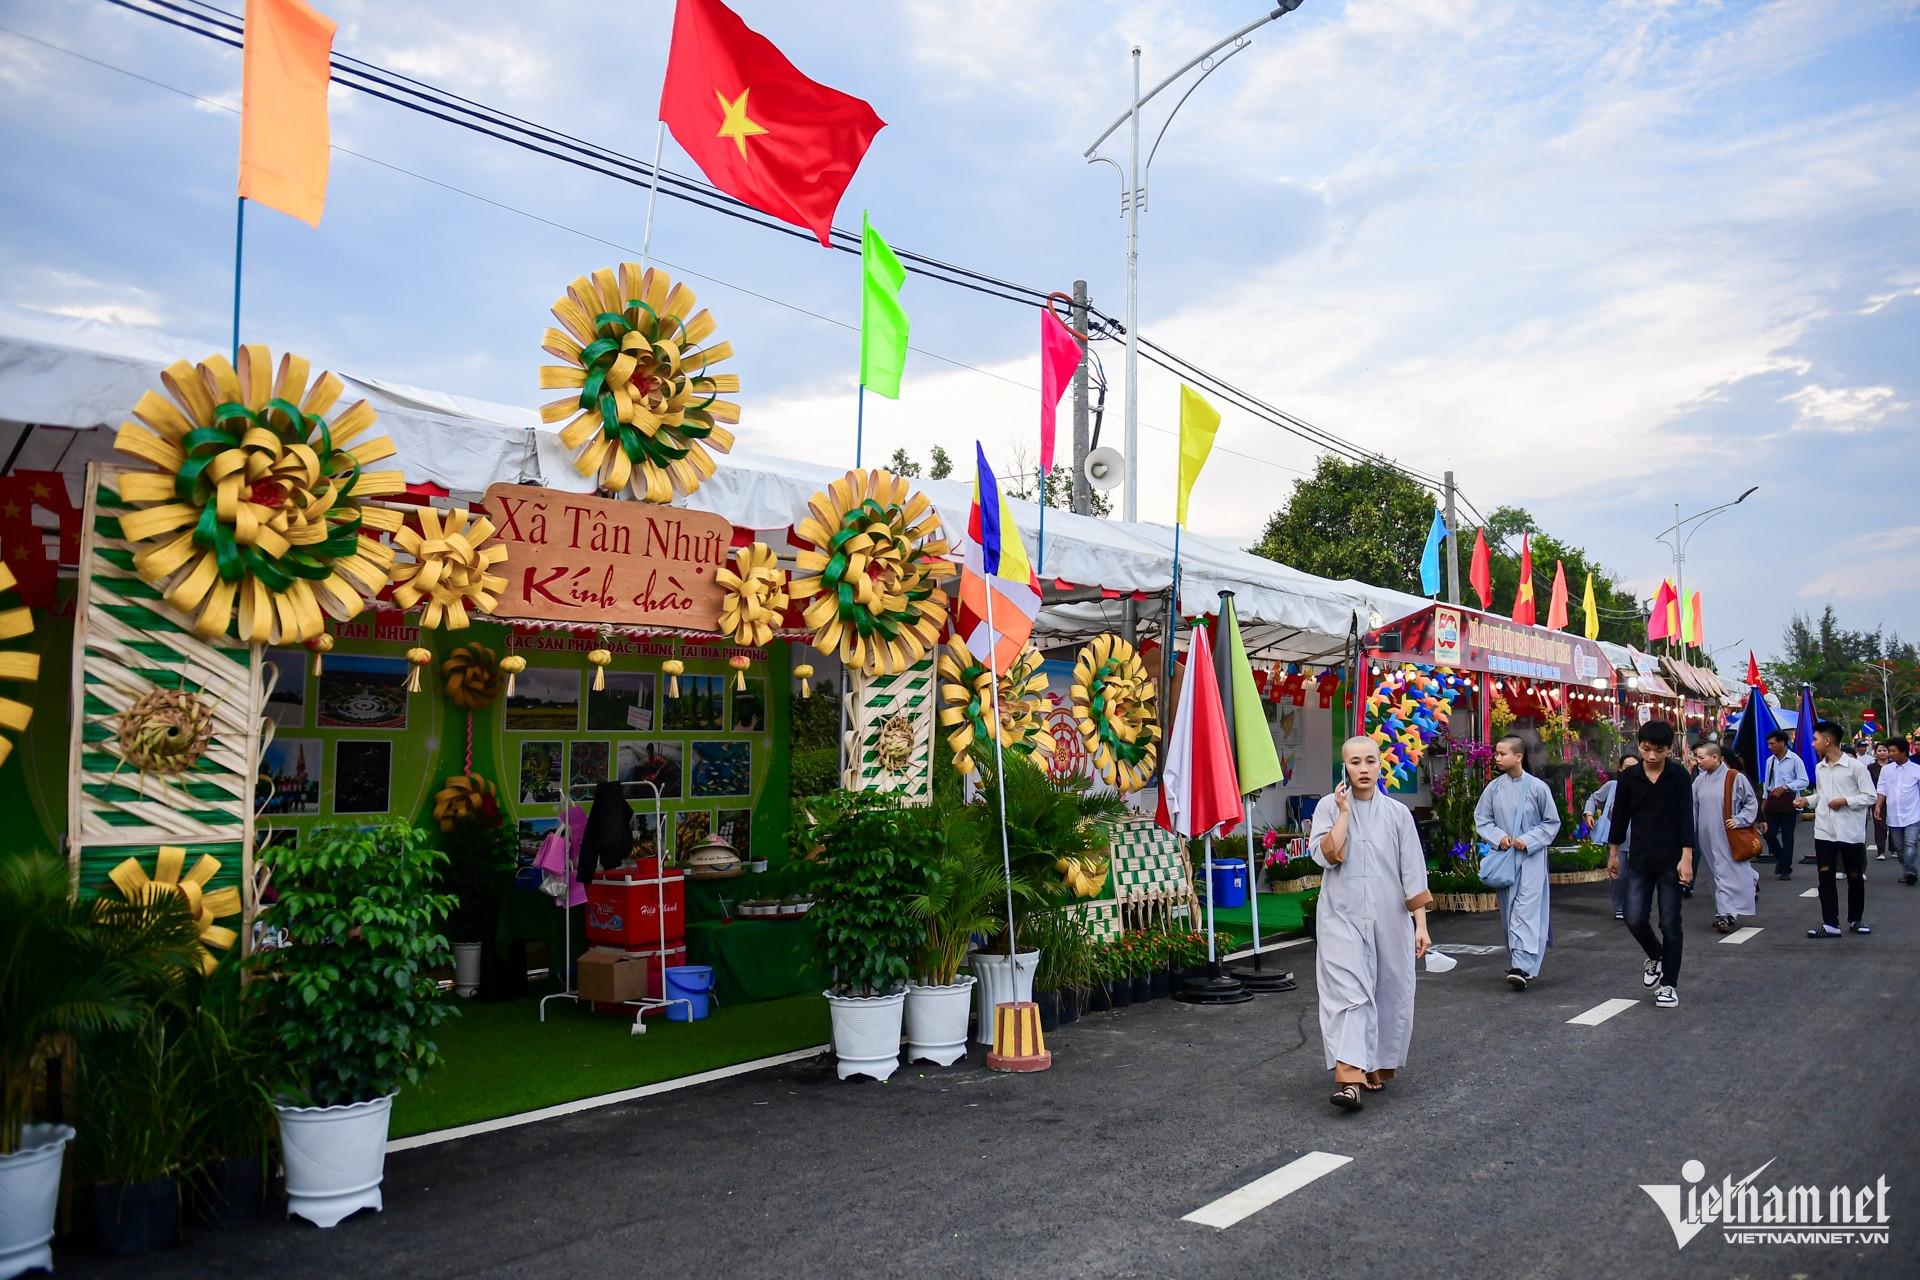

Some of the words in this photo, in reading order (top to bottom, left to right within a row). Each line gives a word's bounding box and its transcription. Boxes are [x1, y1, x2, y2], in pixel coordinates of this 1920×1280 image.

[492, 496, 548, 546] Xã
[564, 506, 631, 555] Tân
[642, 517, 725, 574] Nhựt
[523, 564, 617, 609] Kính
[633, 569, 694, 612] chào
[334, 620, 369, 638] TÂN
[1291, 838, 1302, 858] AN
